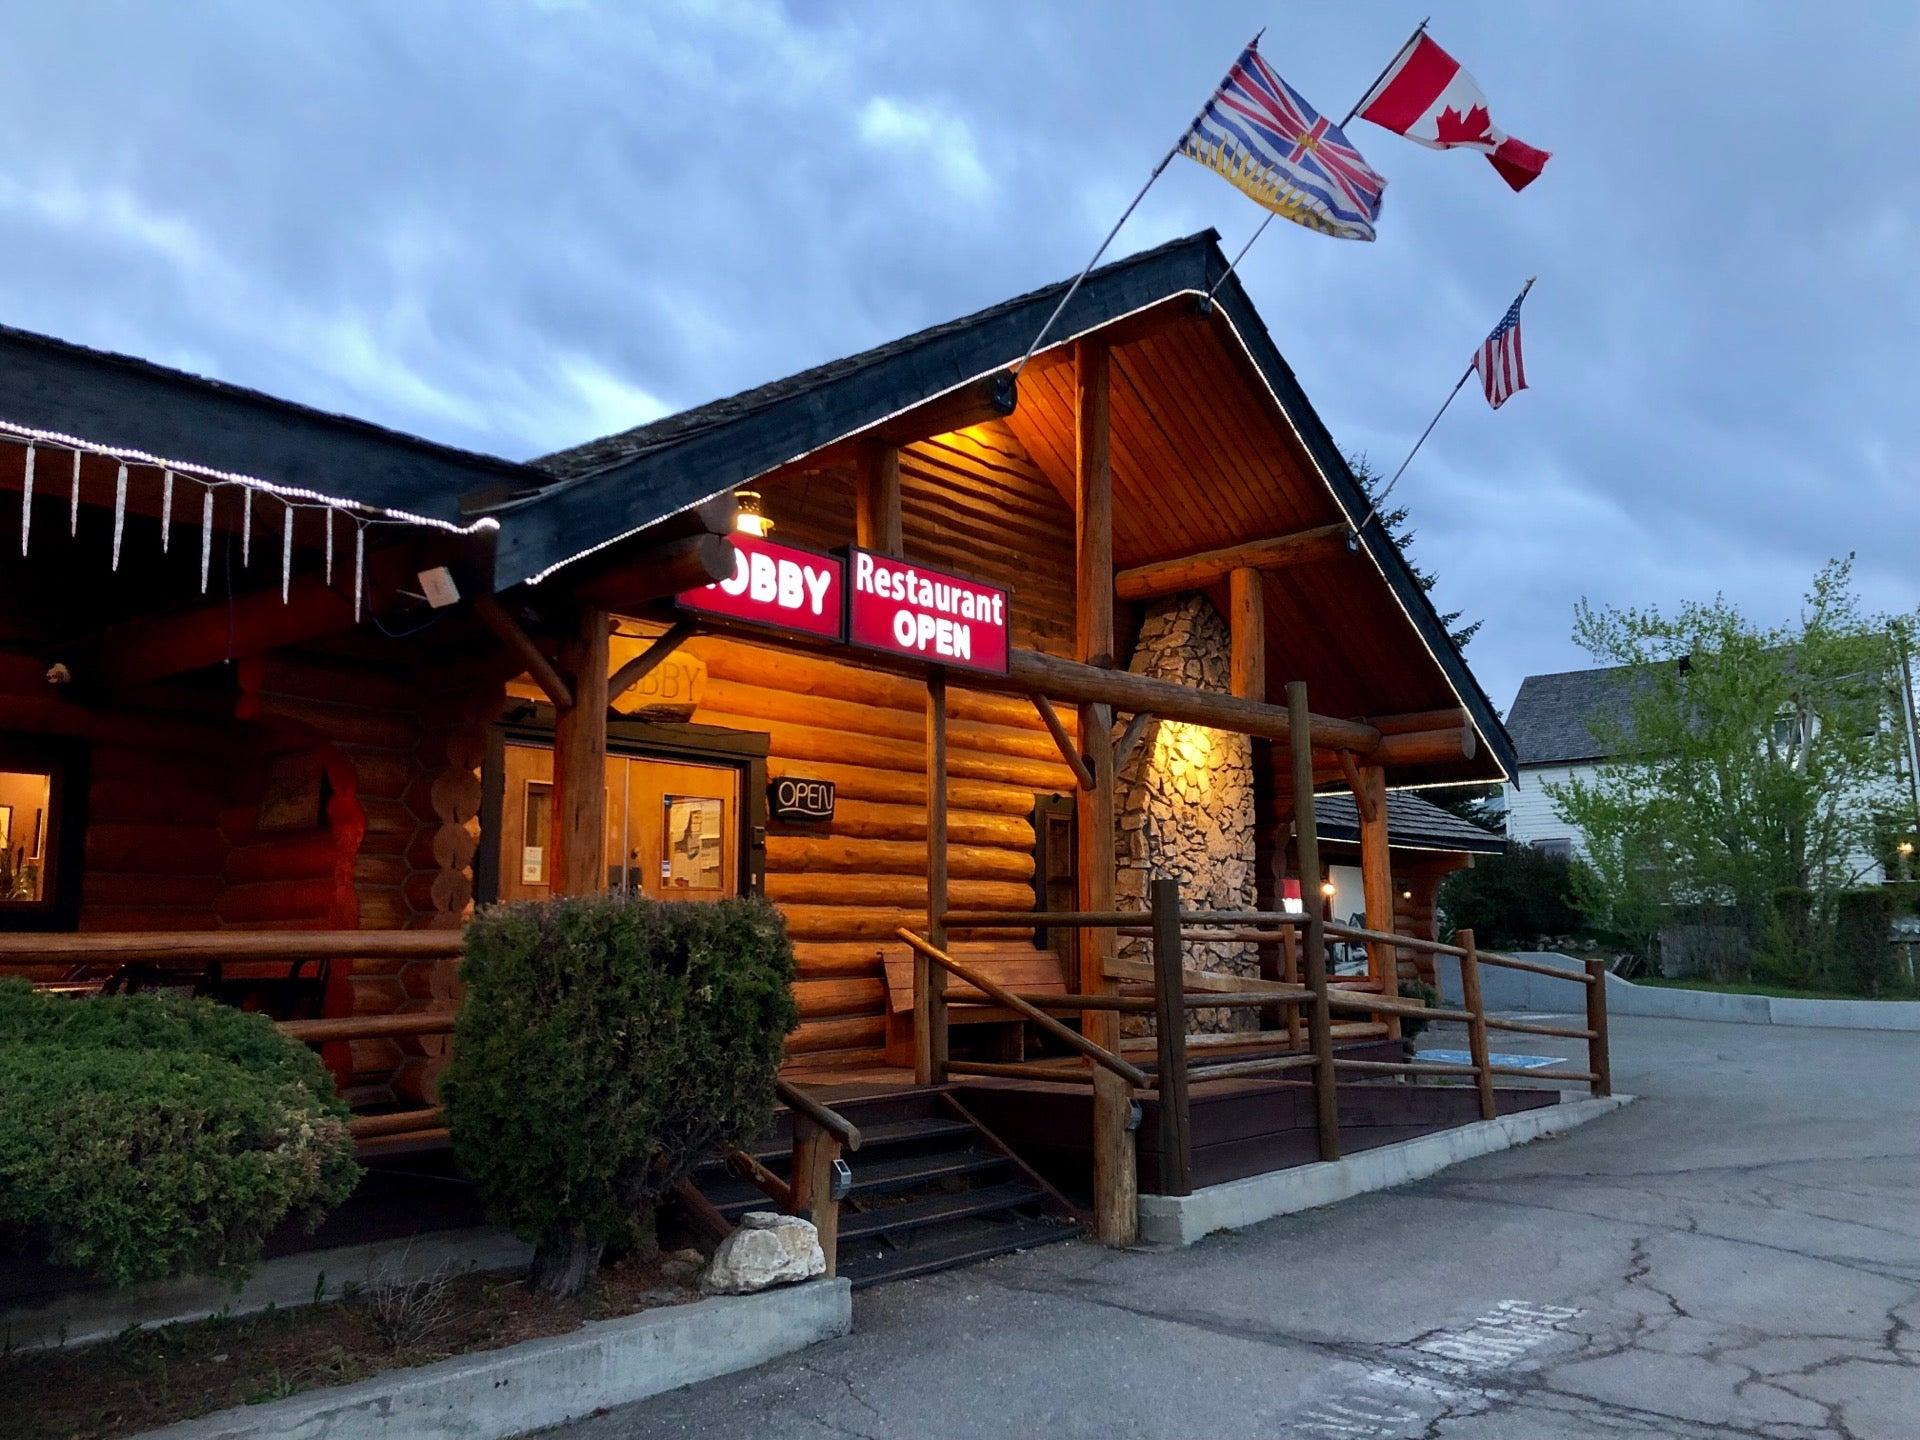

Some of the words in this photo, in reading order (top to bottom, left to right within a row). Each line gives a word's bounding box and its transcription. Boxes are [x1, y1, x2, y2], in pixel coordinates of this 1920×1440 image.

[705, 547, 832, 615] OBBY
[856, 551, 1004, 626] Restaurant
[893, 609, 972, 661] OPEN
[778, 781, 834, 810] OPEN
